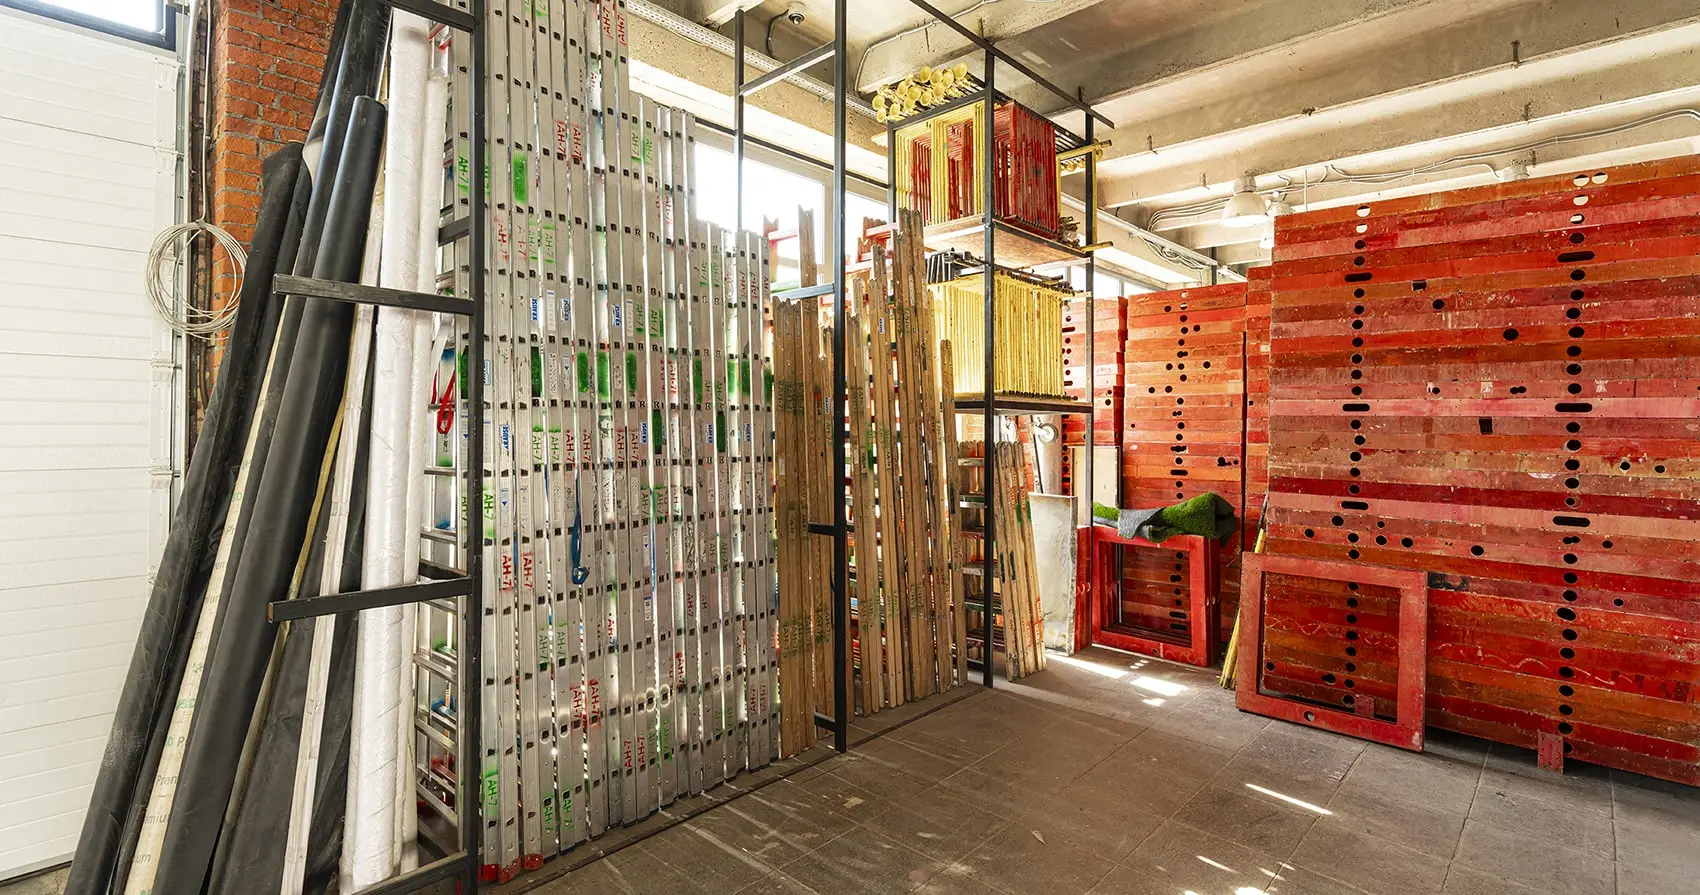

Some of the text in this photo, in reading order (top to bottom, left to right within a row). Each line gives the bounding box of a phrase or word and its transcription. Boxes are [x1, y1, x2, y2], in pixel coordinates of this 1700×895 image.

[557, 124, 566, 158] AH-7
[631, 133, 639, 156] AH-7
[459, 156, 468, 182] AH-7
[545, 234, 553, 257] AH-7
[636, 303, 644, 330] AH-7
[650, 310, 658, 335] AH-7
[532, 436, 541, 460] AH-7
[551, 437, 560, 460] AH-7
[566, 433, 574, 466] AH-7
[617, 434, 625, 460] AH-7
[632, 434, 640, 460] AH-7
[484, 494, 494, 519] AH-7
[503, 555, 512, 590] AH-7
[523, 557, 532, 588] AH-7
[538, 635, 548, 659] AH-7
[573, 690, 582, 720] AH-7
[590, 687, 599, 720] AH-7
[624, 740, 632, 768] AH-7
[637, 736, 646, 768] AH-7
[488, 781, 497, 806] AH-7
